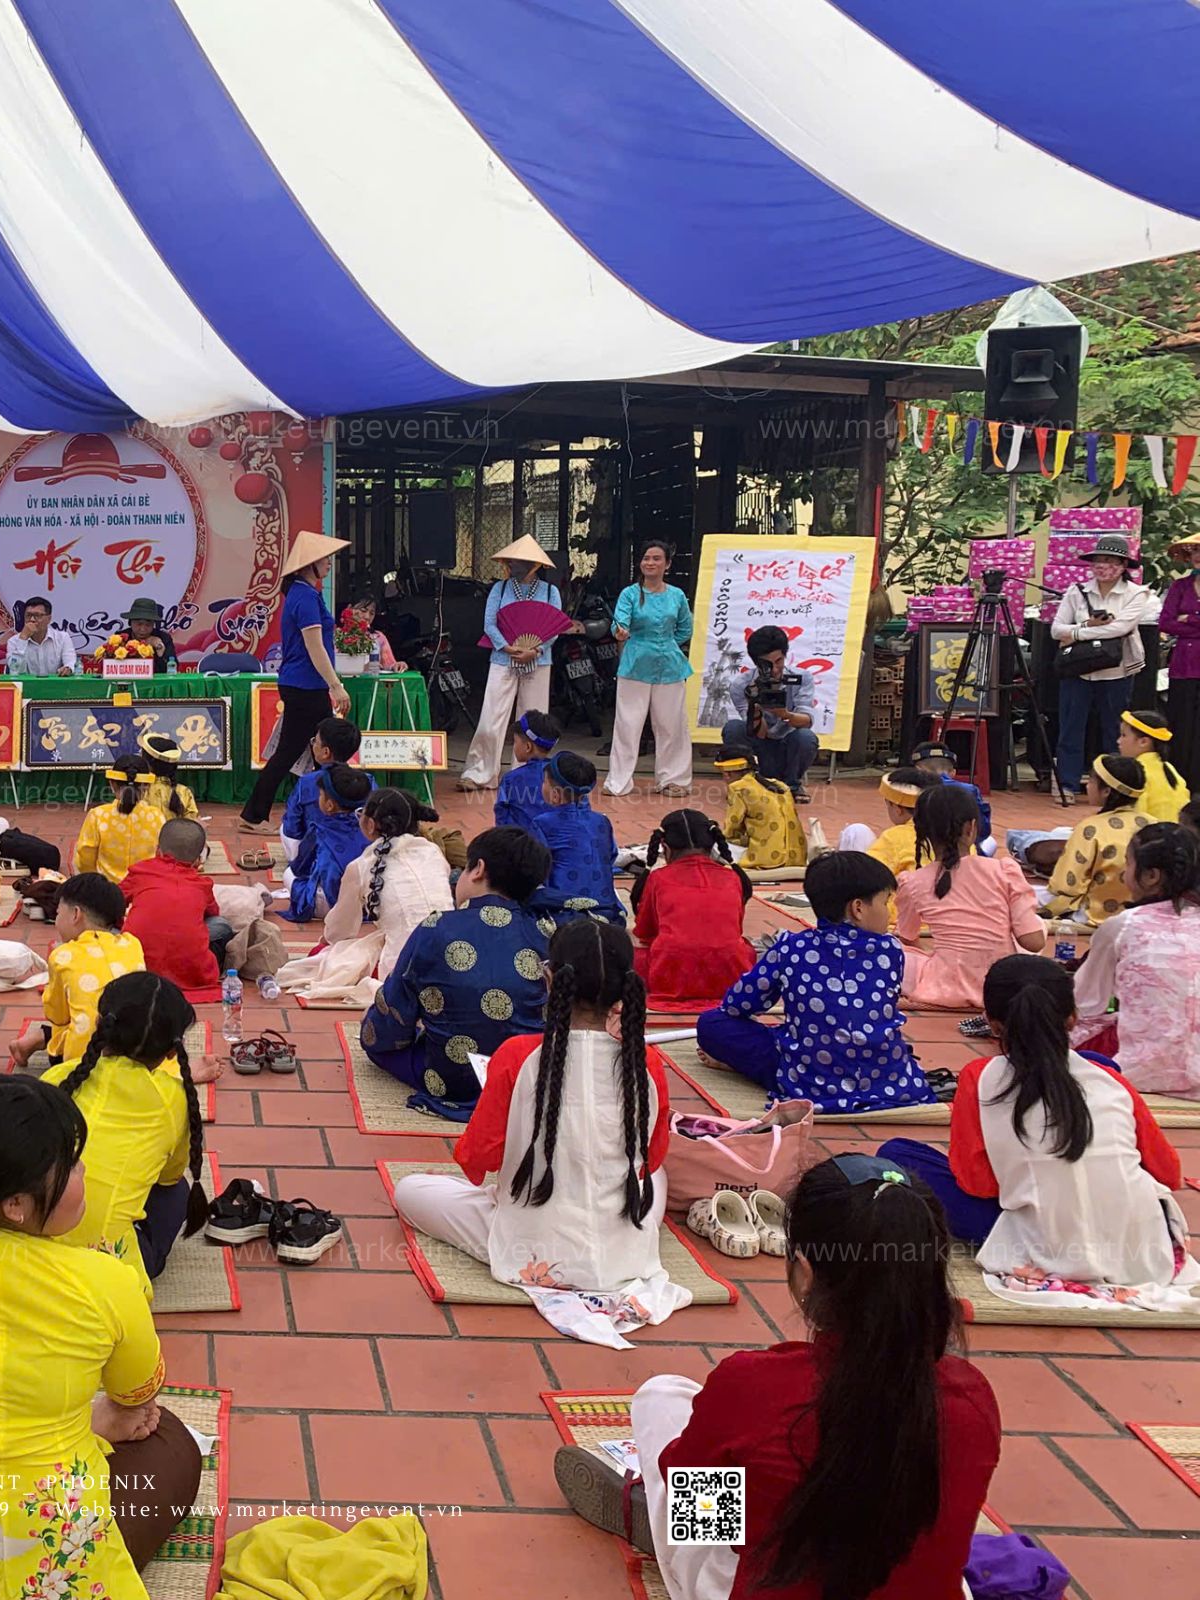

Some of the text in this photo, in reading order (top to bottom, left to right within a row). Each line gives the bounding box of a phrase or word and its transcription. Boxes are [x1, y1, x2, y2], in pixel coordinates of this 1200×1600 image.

[41, 496, 58, 509] BAN
[61, 495, 84, 508] NHÂN
[87, 494, 105, 508] DÂN
[107, 493, 119, 507] XÃ
[121, 493, 136, 507] CÁI
[44, 512, 62, 527] HÓA
[70, 513, 82, 527] XÃ
[83, 511, 99, 528] HỘI
[107, 512, 131, 526] ĐOÀN
[134, 513, 162, 526] THANH
[164, 510, 185, 525] NIÊN
[103, 538, 166, 585] Thi
[714, 1182, 759, 1194] merci
